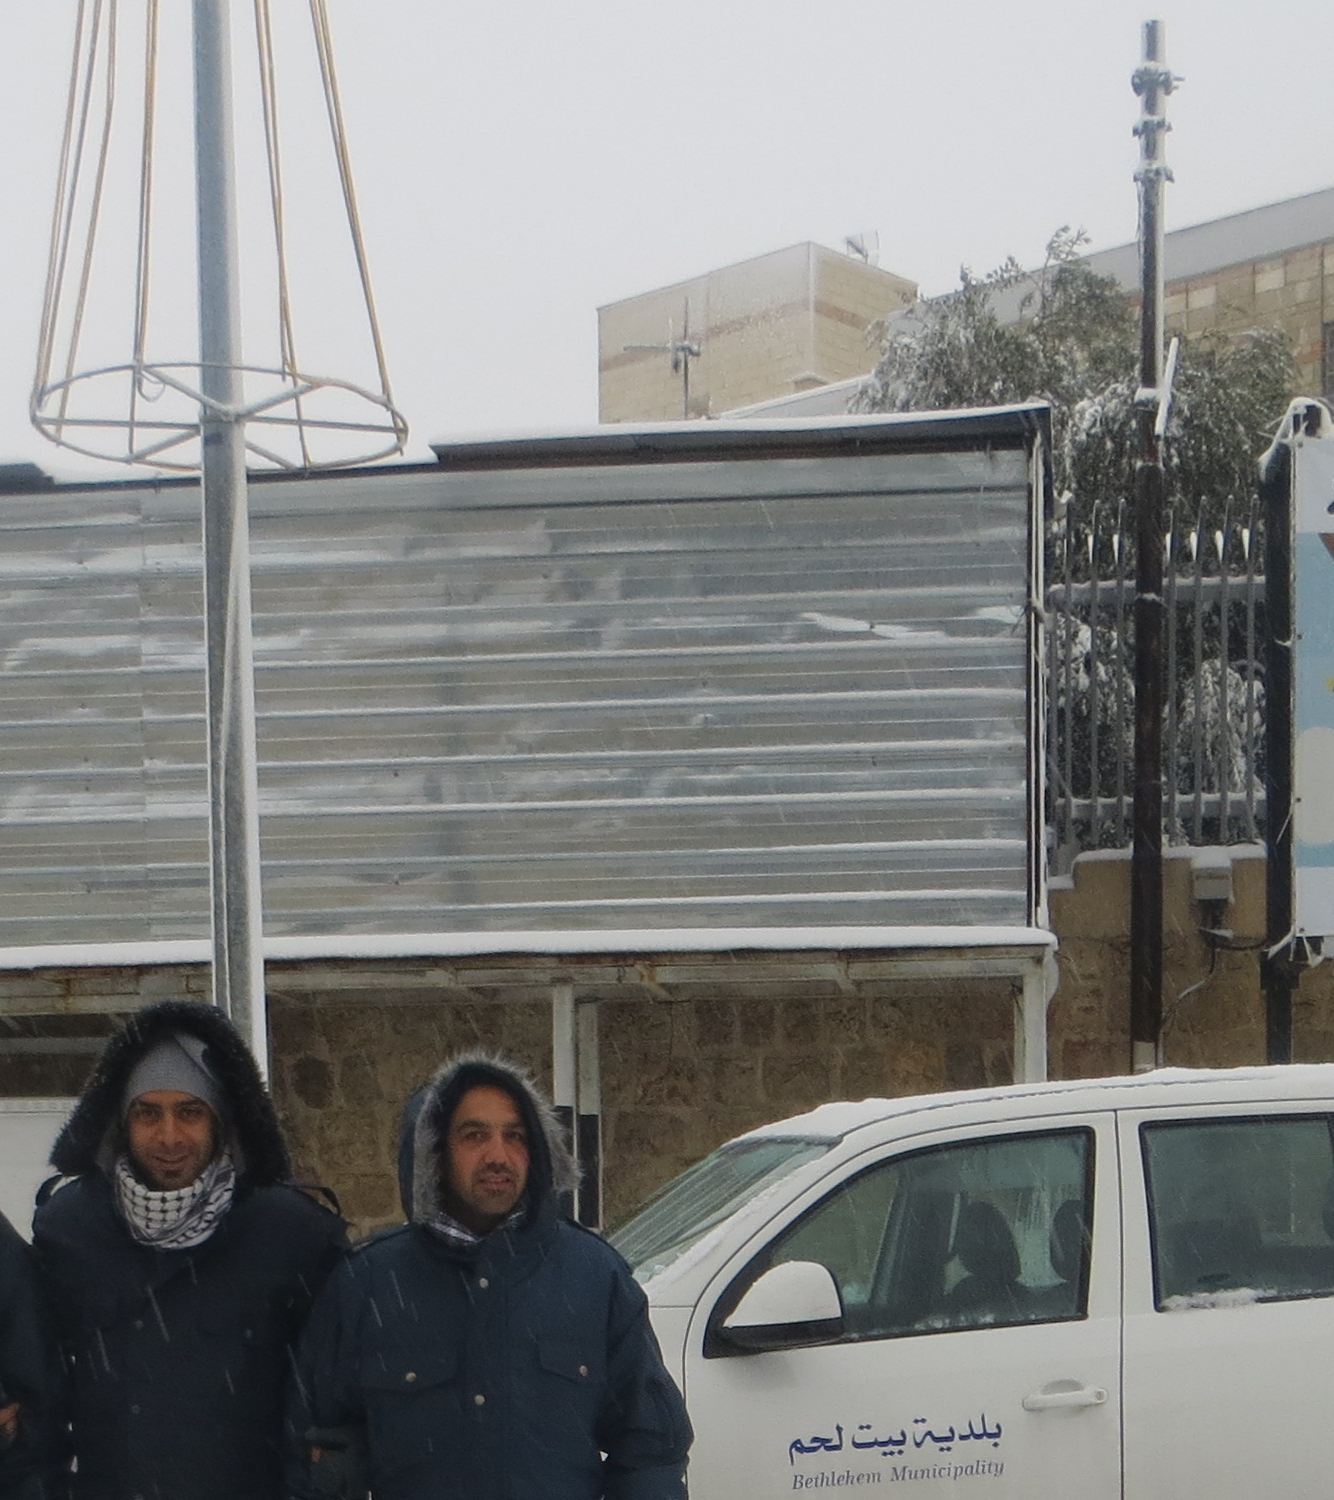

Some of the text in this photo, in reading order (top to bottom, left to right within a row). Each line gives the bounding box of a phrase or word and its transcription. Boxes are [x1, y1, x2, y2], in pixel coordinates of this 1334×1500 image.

[787, 1413, 1003, 1466] بلدية بيت لحم
[792, 1459, 1005, 1491] Bethlehem Municipality
